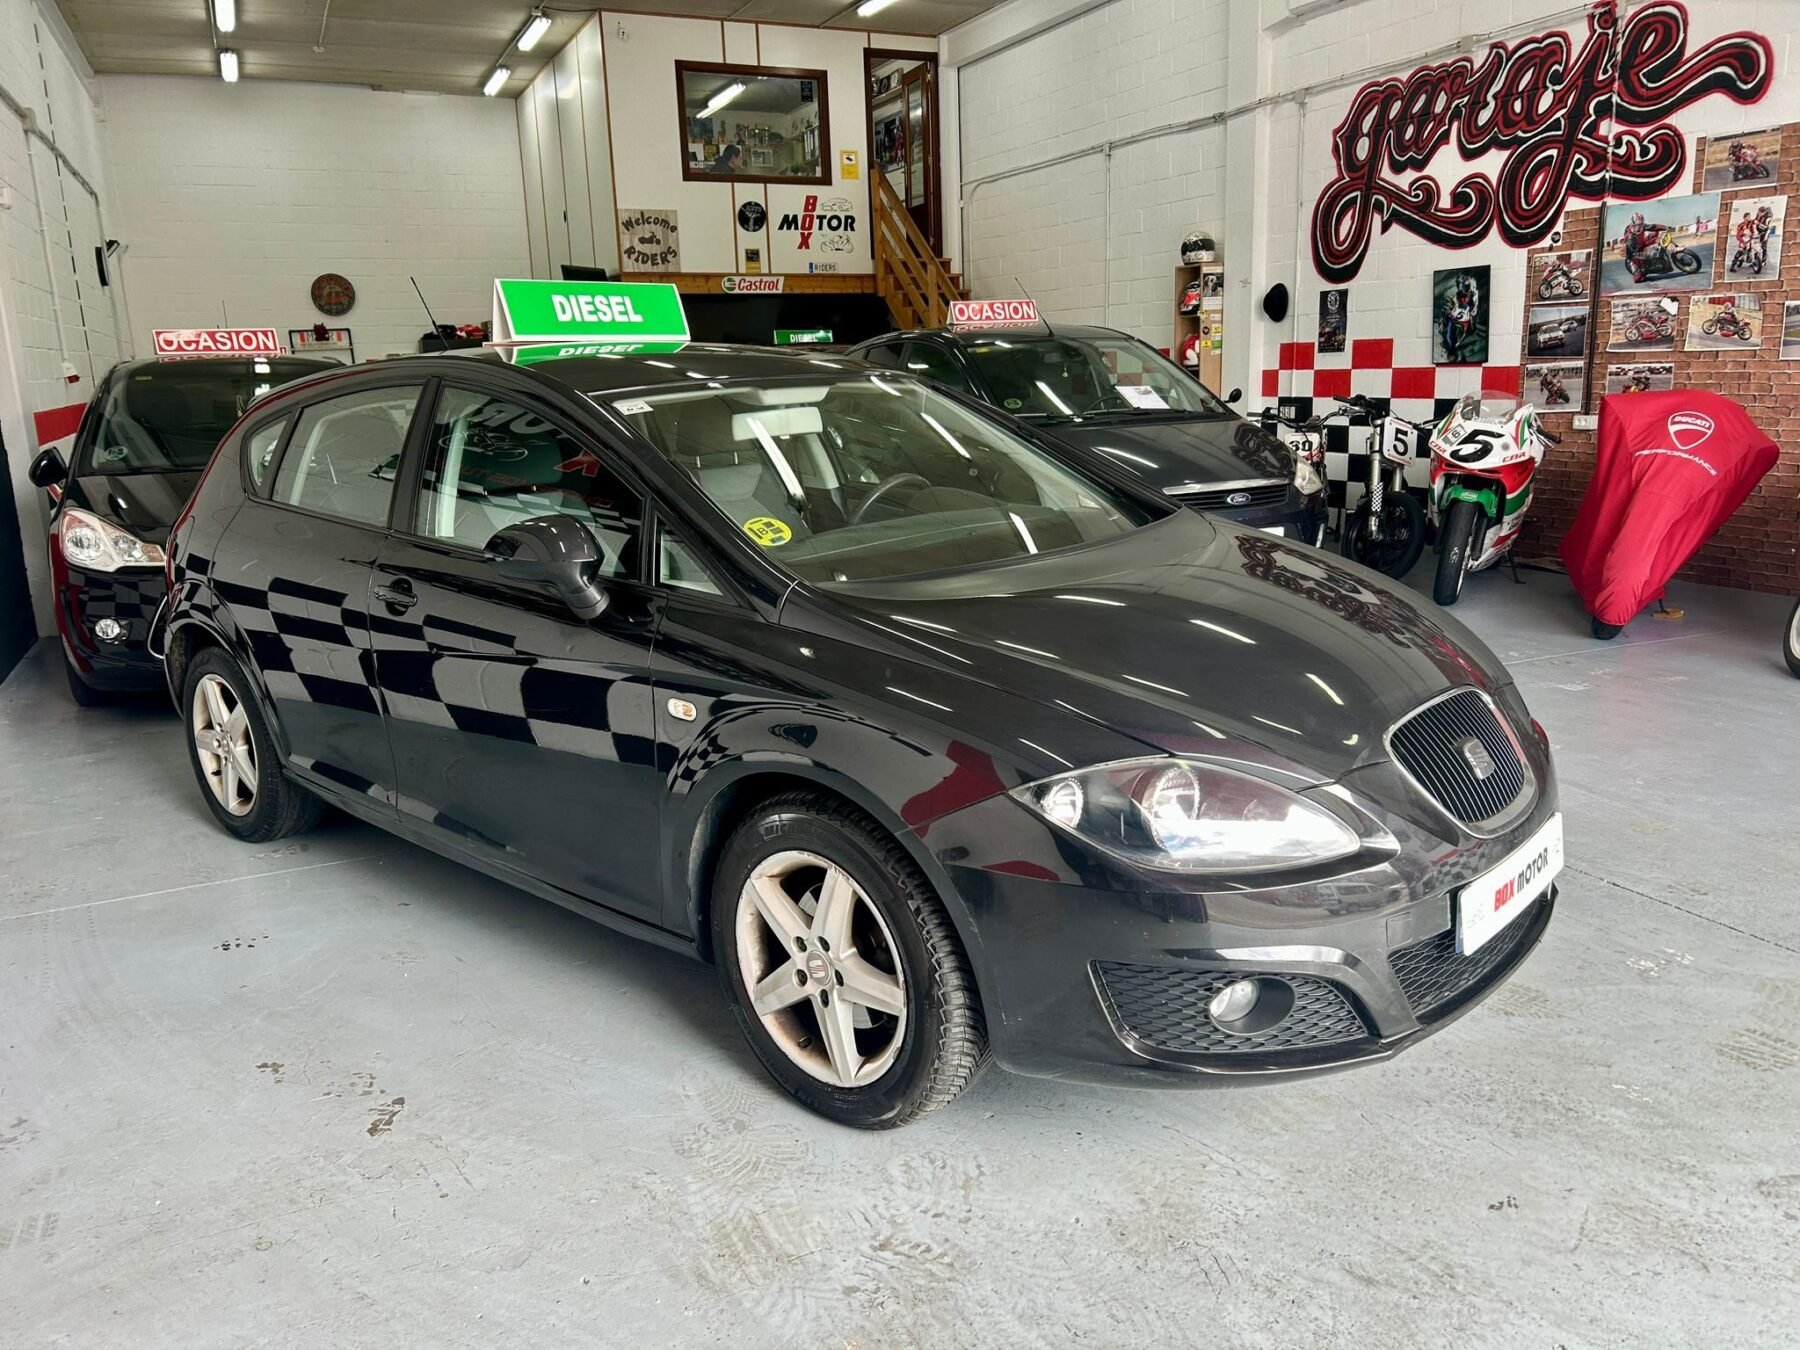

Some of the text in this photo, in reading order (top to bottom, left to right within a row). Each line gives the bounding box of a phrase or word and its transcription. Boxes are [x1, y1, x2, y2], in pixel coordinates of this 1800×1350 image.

[1312, 0, 1774, 284] garaje
[621, 211, 678, 233] Welcome
[777, 214, 856, 232] MOTOR
[797, 195, 818, 250] BOX
[623, 245, 678, 267] RIDERS
[814, 263, 837, 272] RIDERS
[737, 277, 780, 292] Castrol
[551, 294, 644, 323] DIESEL
[955, 302, 1036, 321] OCASION
[158, 331, 276, 351] OCASION
[790, 333, 818, 343] DIESEL
[1672, 415, 1710, 428] DUCATI
[1392, 427, 1409, 457] 5
[1449, 428, 1506, 463] 5
[1502, 451, 1527, 463] CBR
[1494, 847, 1548, 912] BOX MOTOR
